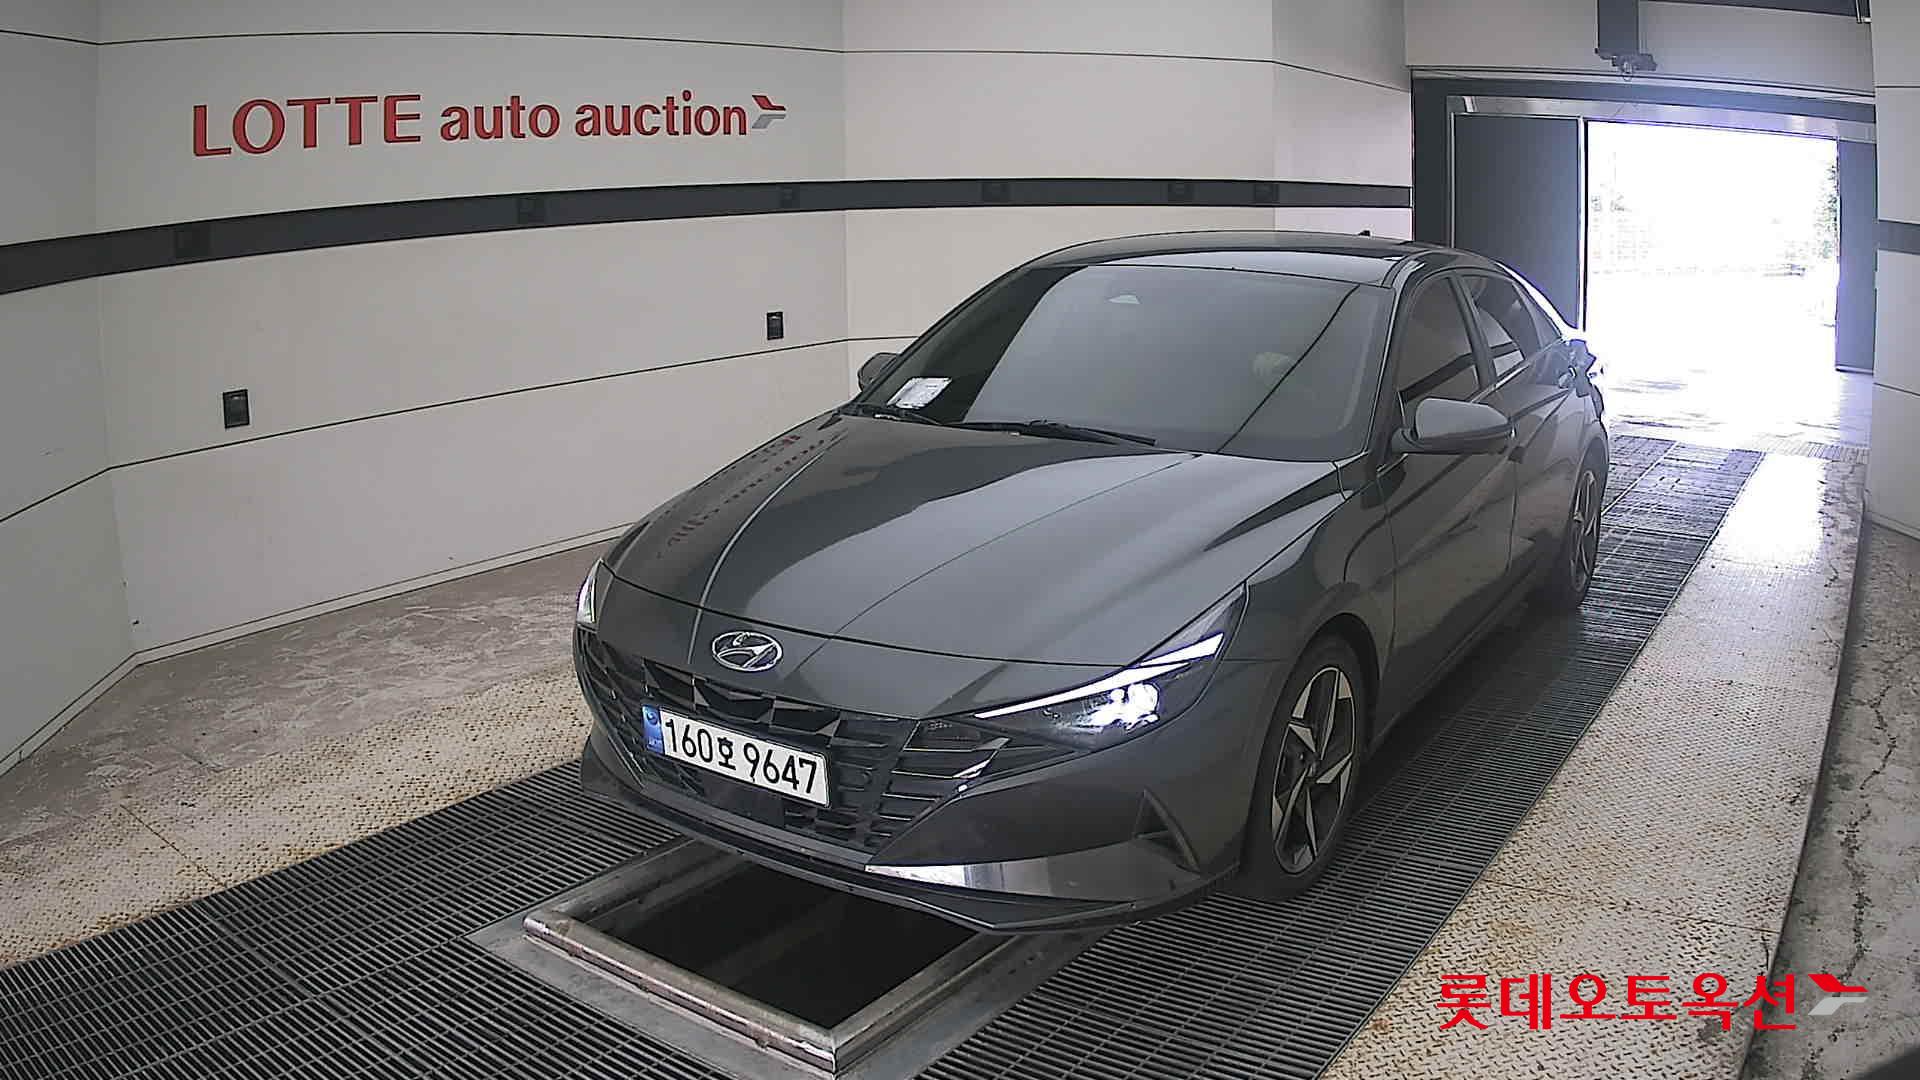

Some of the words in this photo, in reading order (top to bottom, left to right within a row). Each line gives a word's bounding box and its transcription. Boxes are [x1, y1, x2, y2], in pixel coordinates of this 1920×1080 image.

[193, 94, 421, 157] LOTTE
[440, 95, 560, 141] auto
[575, 90, 747, 138] auction
